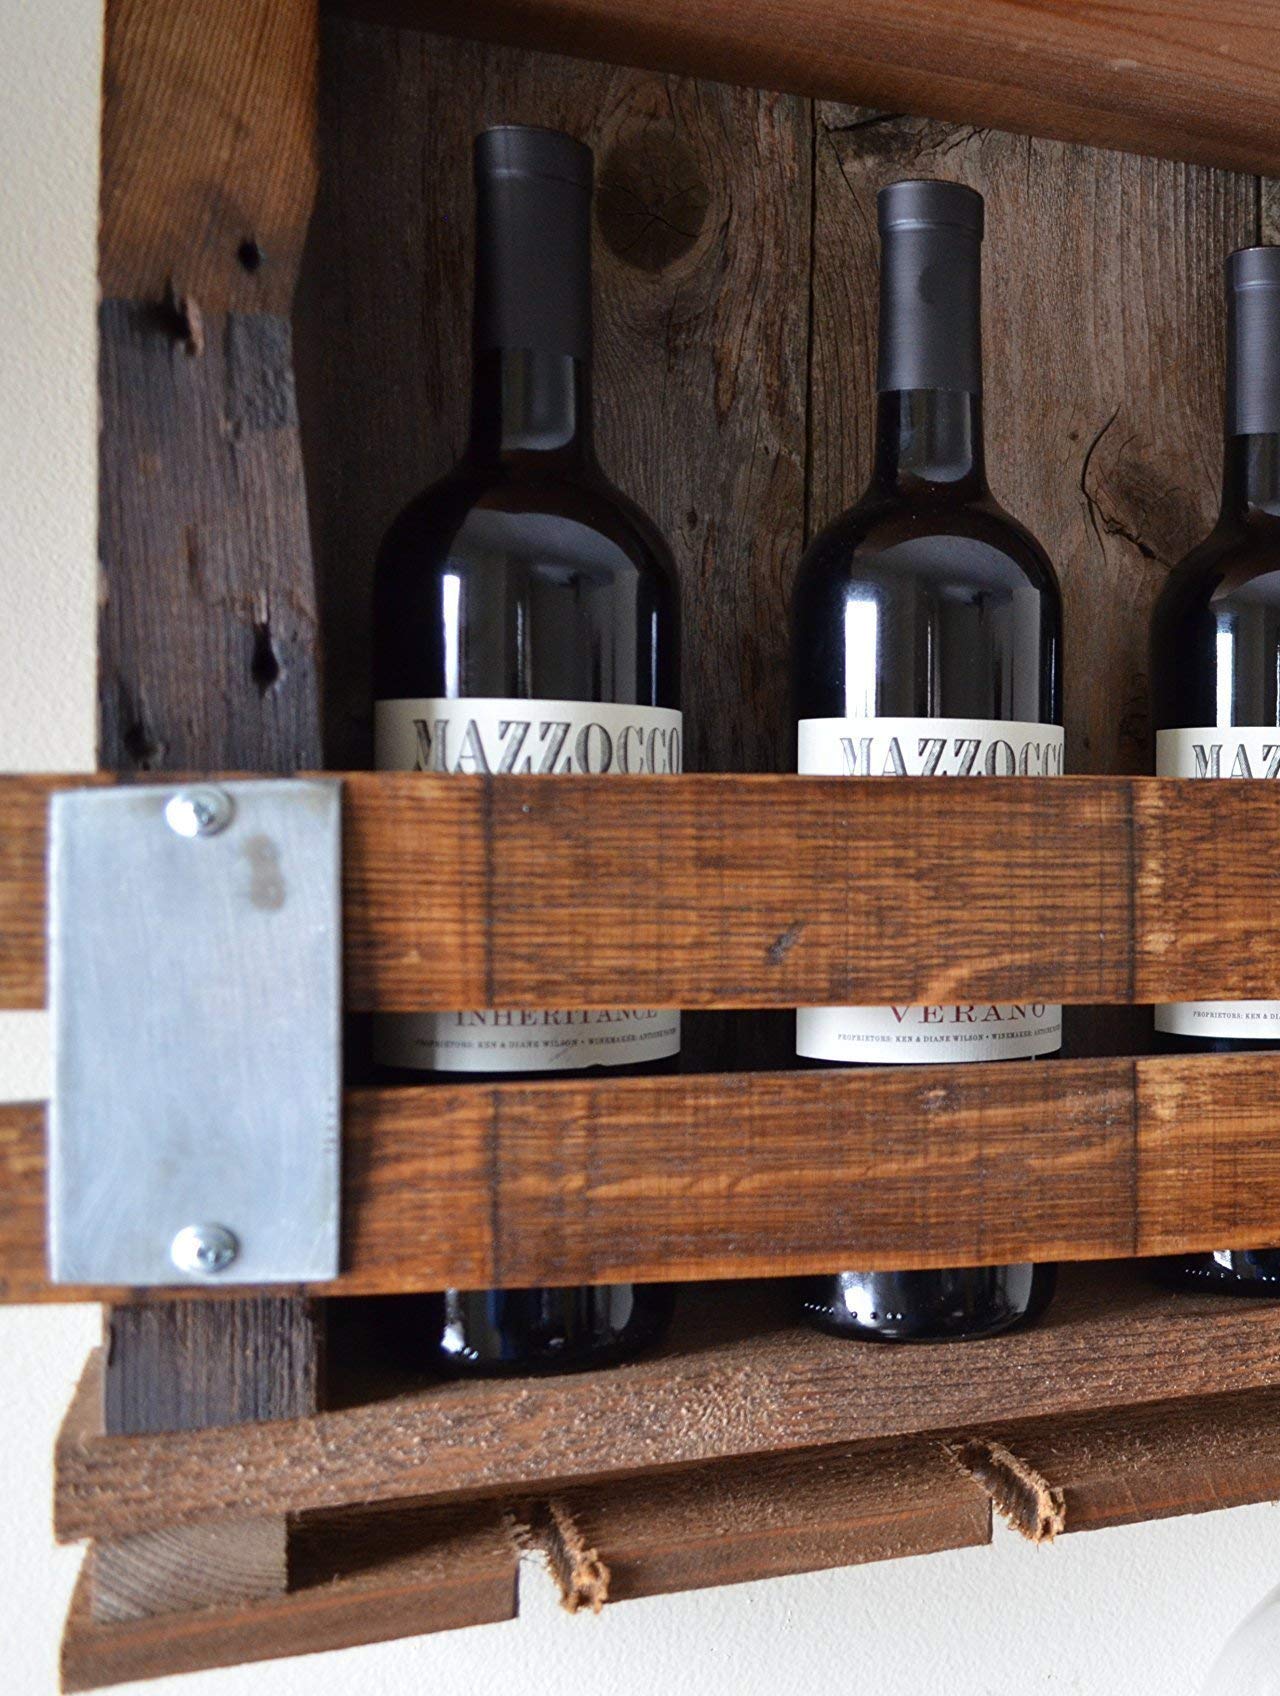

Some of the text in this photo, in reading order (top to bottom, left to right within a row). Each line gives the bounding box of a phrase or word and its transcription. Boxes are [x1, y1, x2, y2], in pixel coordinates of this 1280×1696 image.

[412, 717, 680, 775] MAZZOCCO
[889, 1003, 1046, 1024] VERANO
[895, 1035, 913, 1043] KEN
